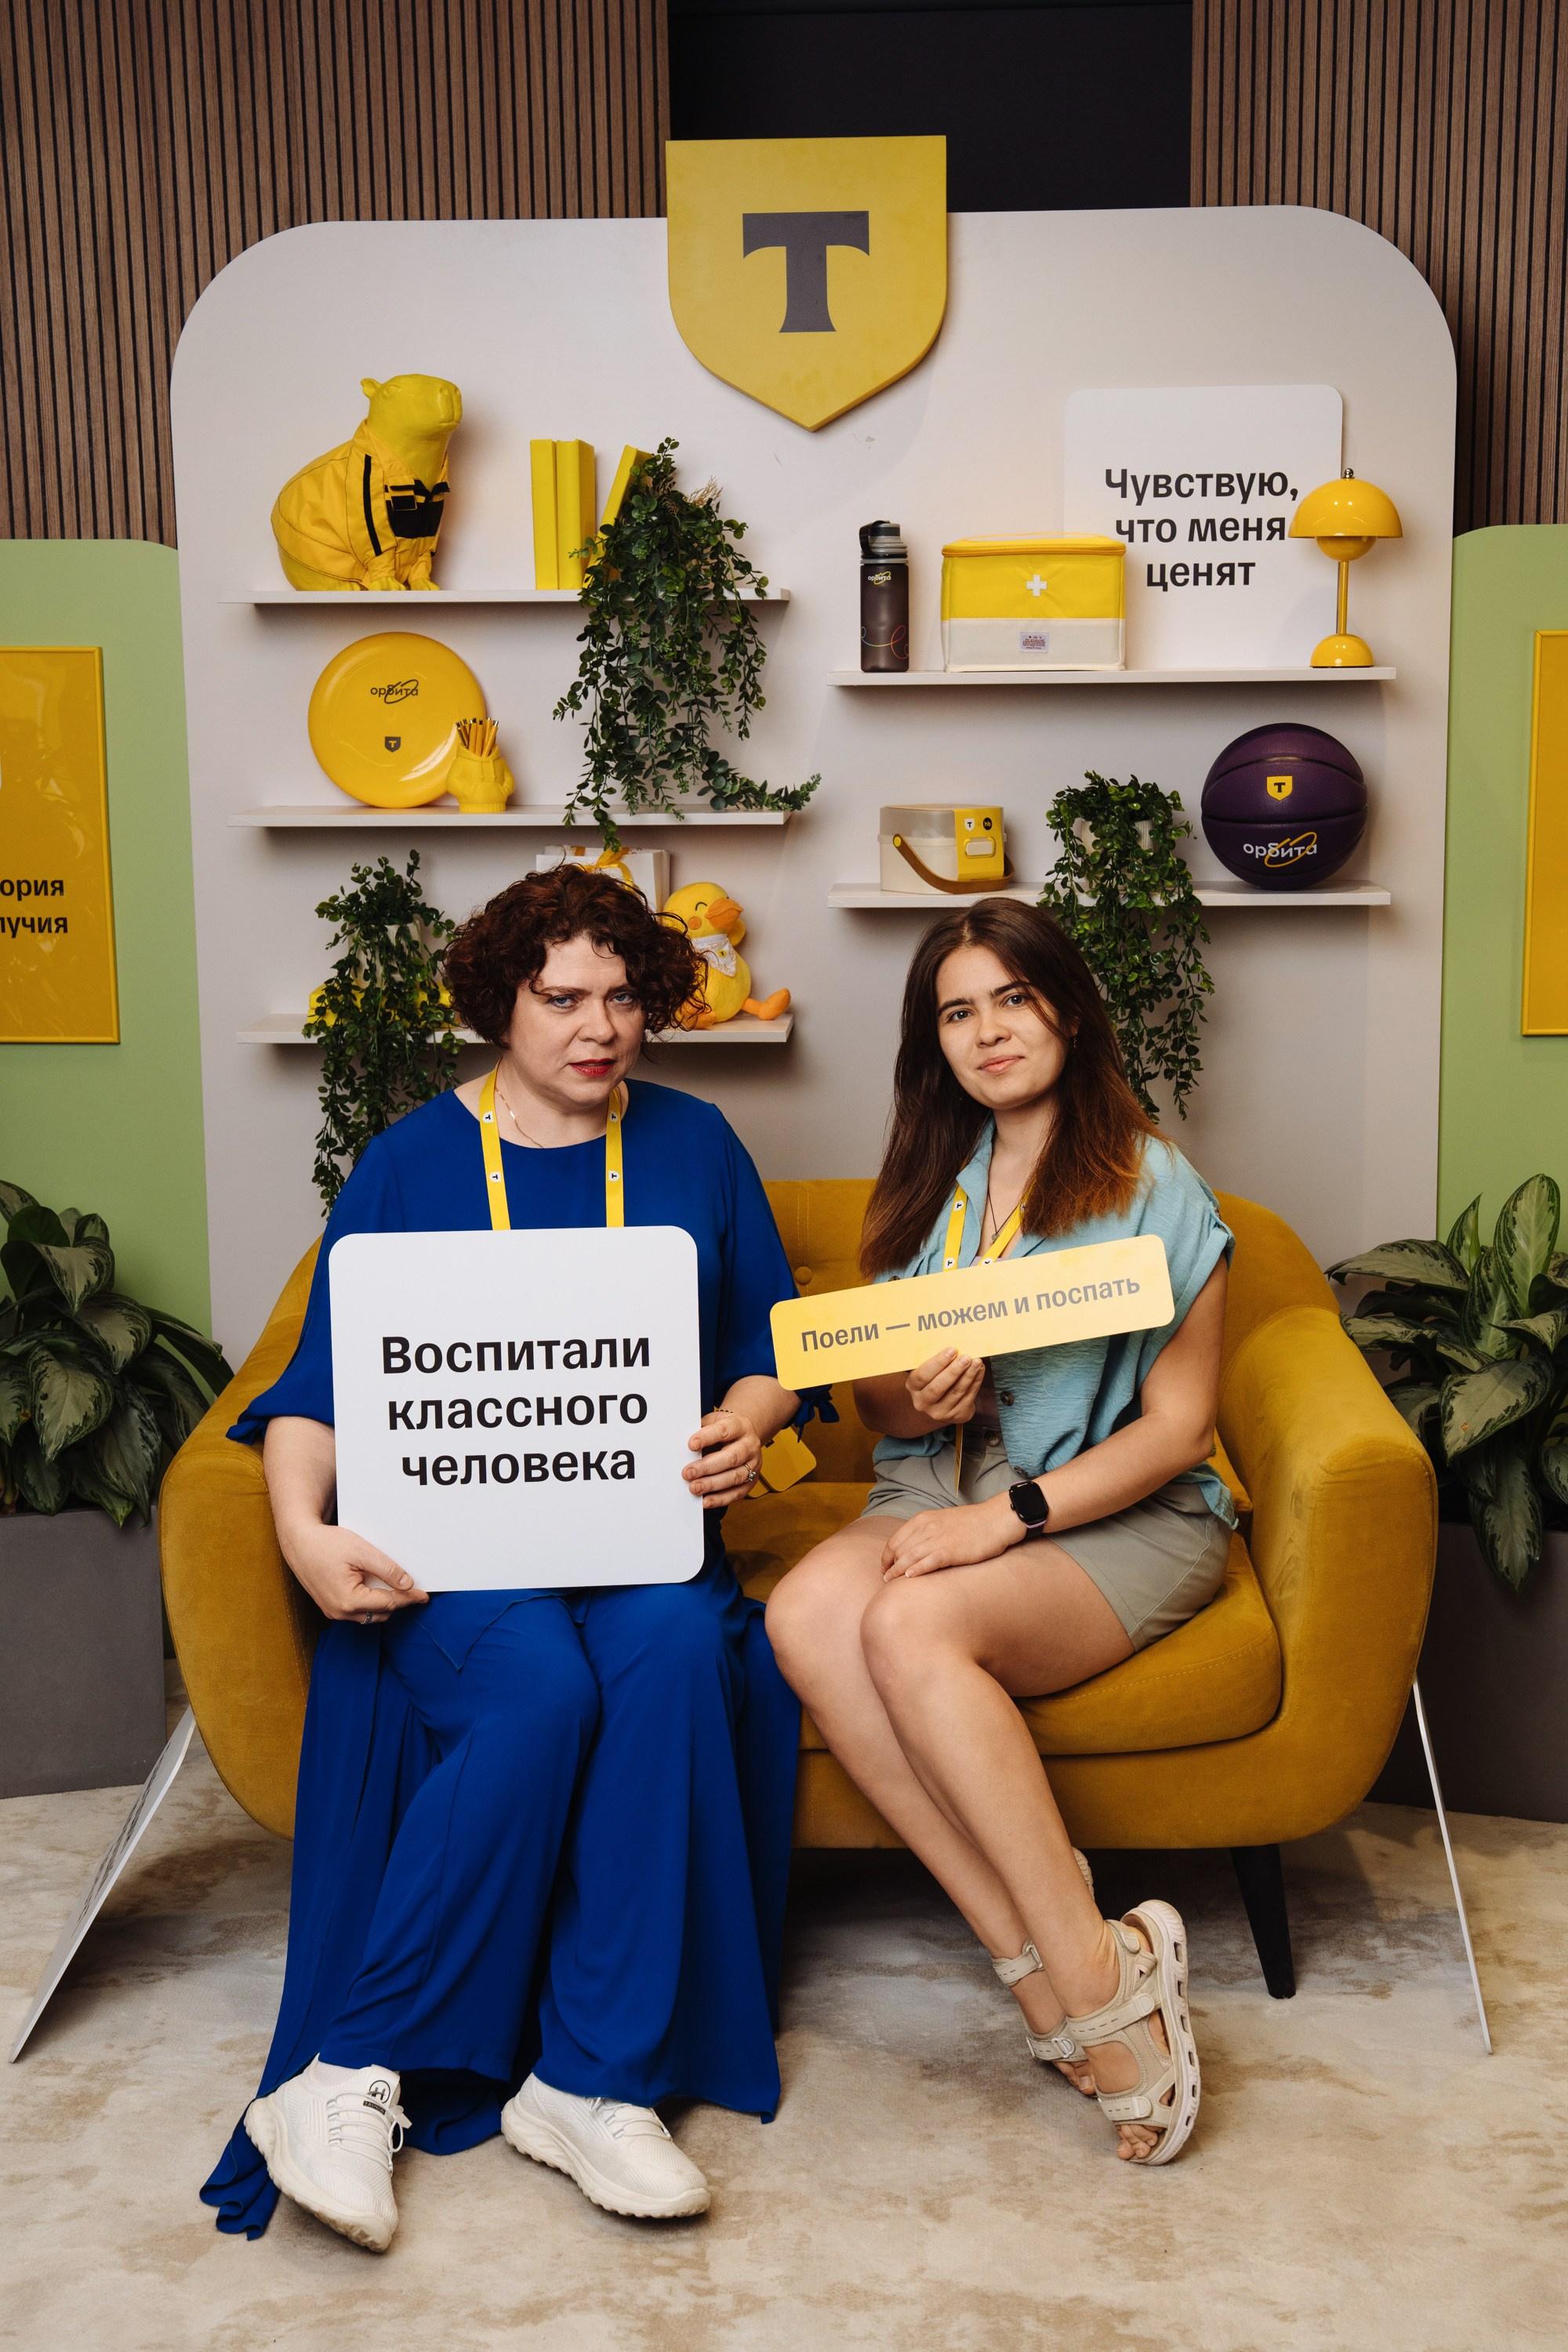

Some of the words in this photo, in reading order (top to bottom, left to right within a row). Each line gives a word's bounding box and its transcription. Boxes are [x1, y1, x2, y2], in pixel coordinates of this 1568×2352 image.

[1105, 468, 1299, 506] Чувствую,
[1115, 518, 1177, 543] что
[1188, 517, 1286, 543] меня
[1146, 561, 1256, 592] ценят
[370, 682, 419, 699] орбита
[1243, 839, 1318, 862] орбита
[0, 879, 64, 902] ория
[801, 1323, 880, 1352] Поели
[916, 1300, 1009, 1332] можем
[1014, 1296, 1030, 1315] и
[1036, 1276, 1142, 1311] поспать
[382, 1336, 650, 1374] Воспитали
[388, 1392, 648, 1431] классного
[402, 1448, 636, 1486] человека
